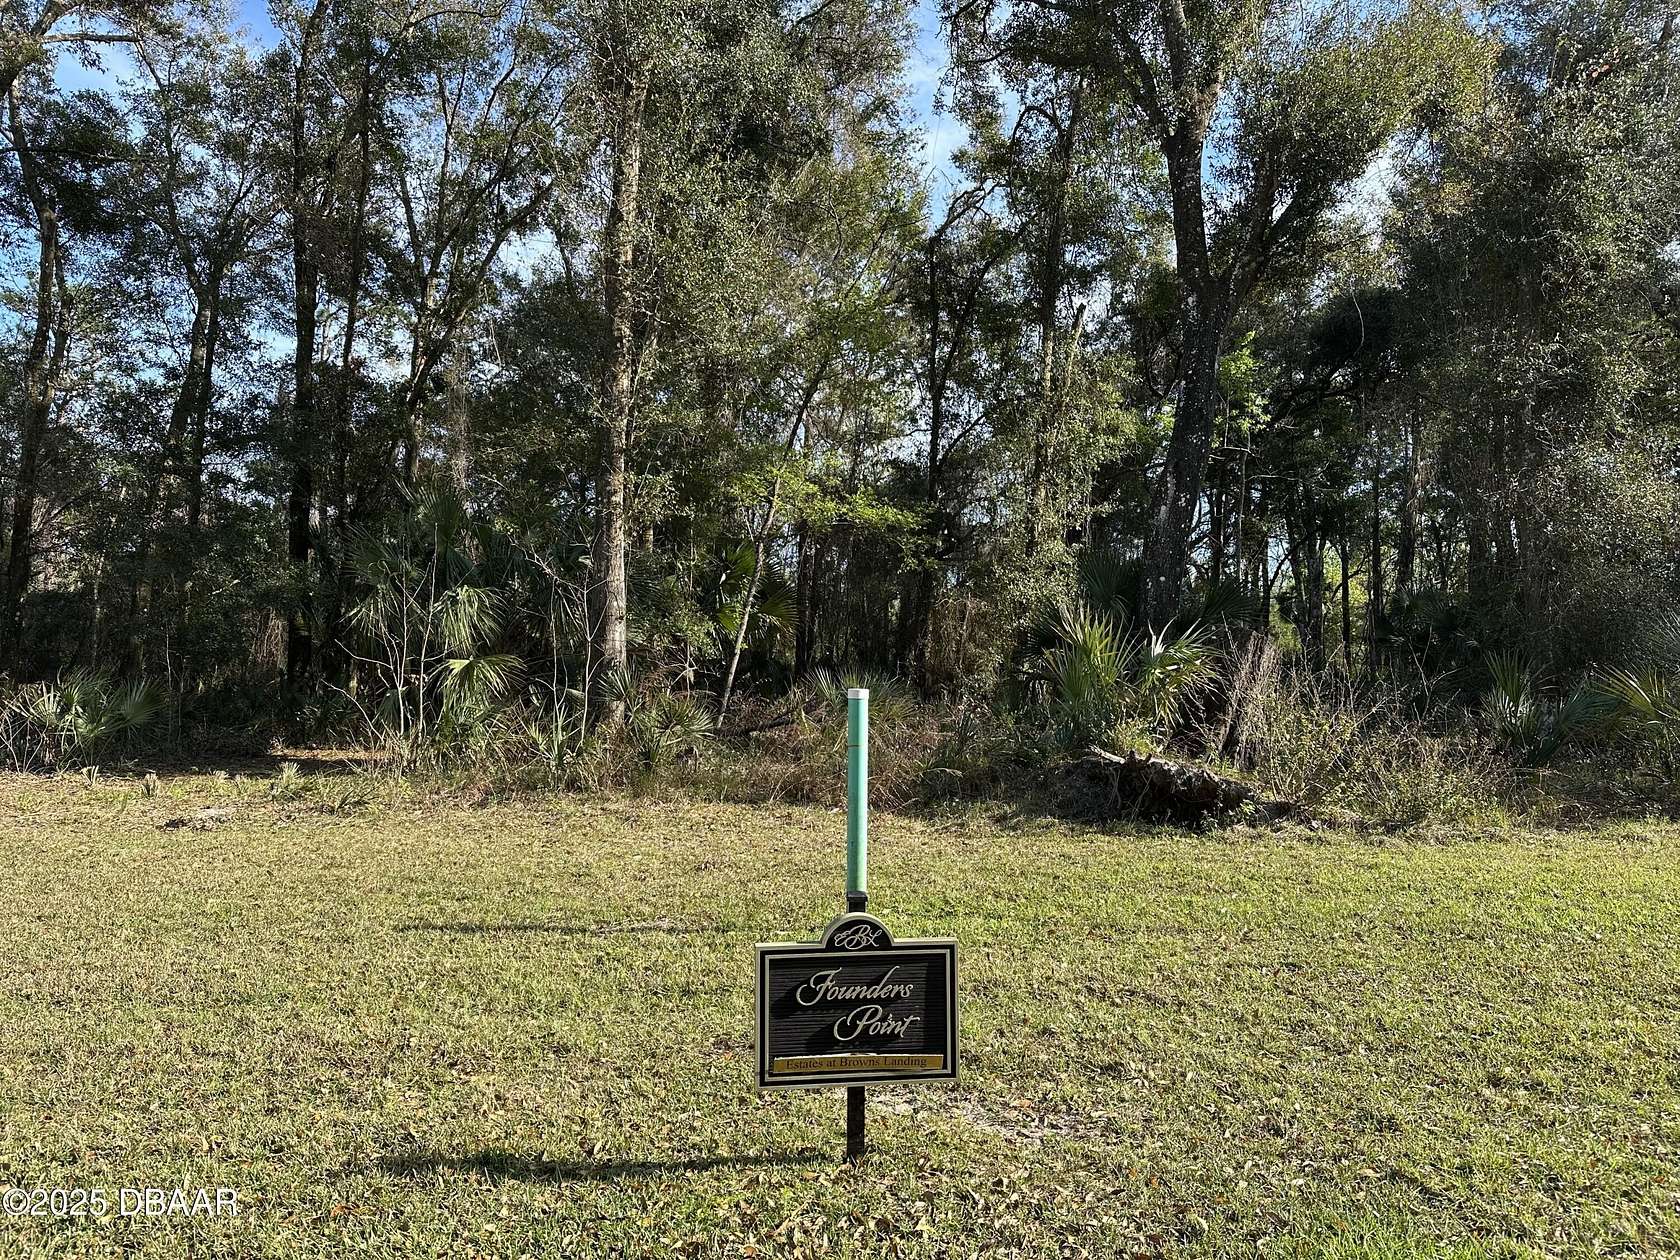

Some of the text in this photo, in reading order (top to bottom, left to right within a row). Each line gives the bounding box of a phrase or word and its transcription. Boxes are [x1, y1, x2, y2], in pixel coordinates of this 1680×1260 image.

[796, 965, 914, 1006] Founders
[833, 1004, 921, 1041] Point
[786, 1056, 927, 1070] Estates at Browns Landing
